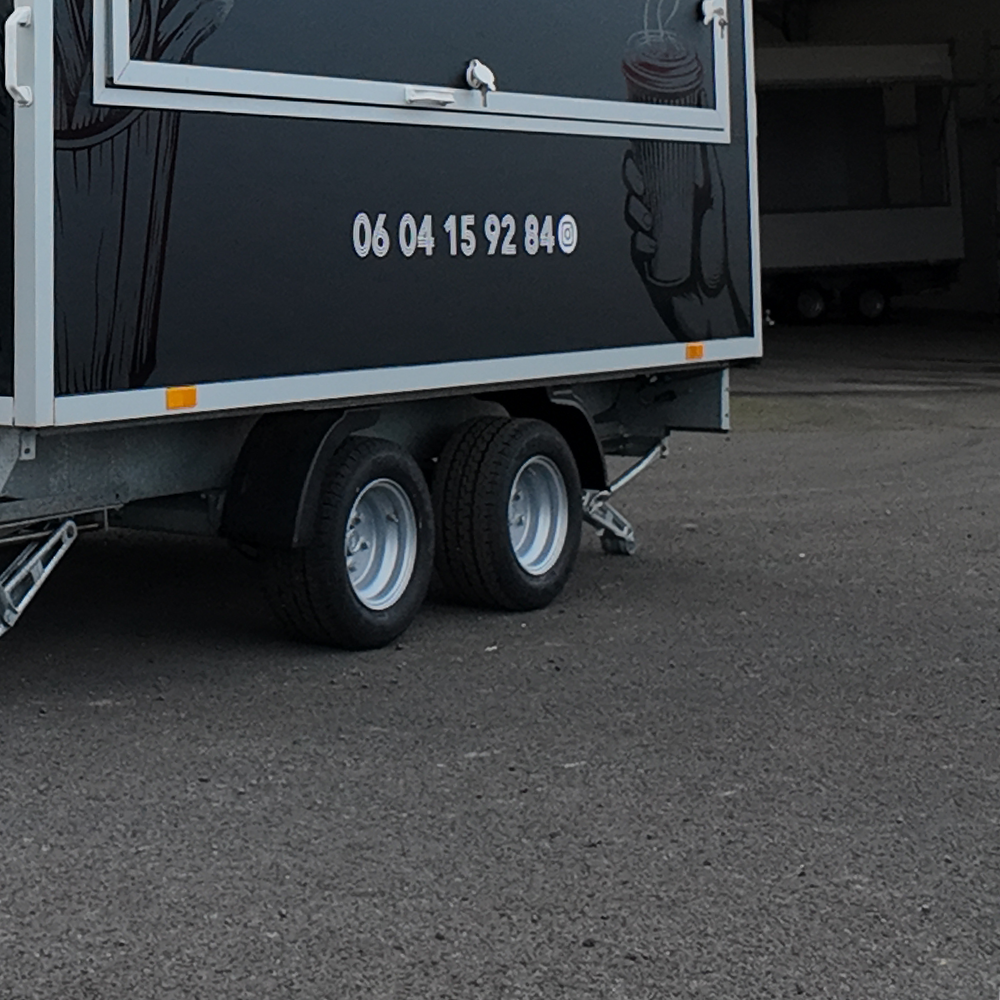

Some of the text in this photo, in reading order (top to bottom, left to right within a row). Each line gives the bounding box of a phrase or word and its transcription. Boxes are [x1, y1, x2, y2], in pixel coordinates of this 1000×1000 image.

[352, 212, 555, 258] 06 04 15 92 84
